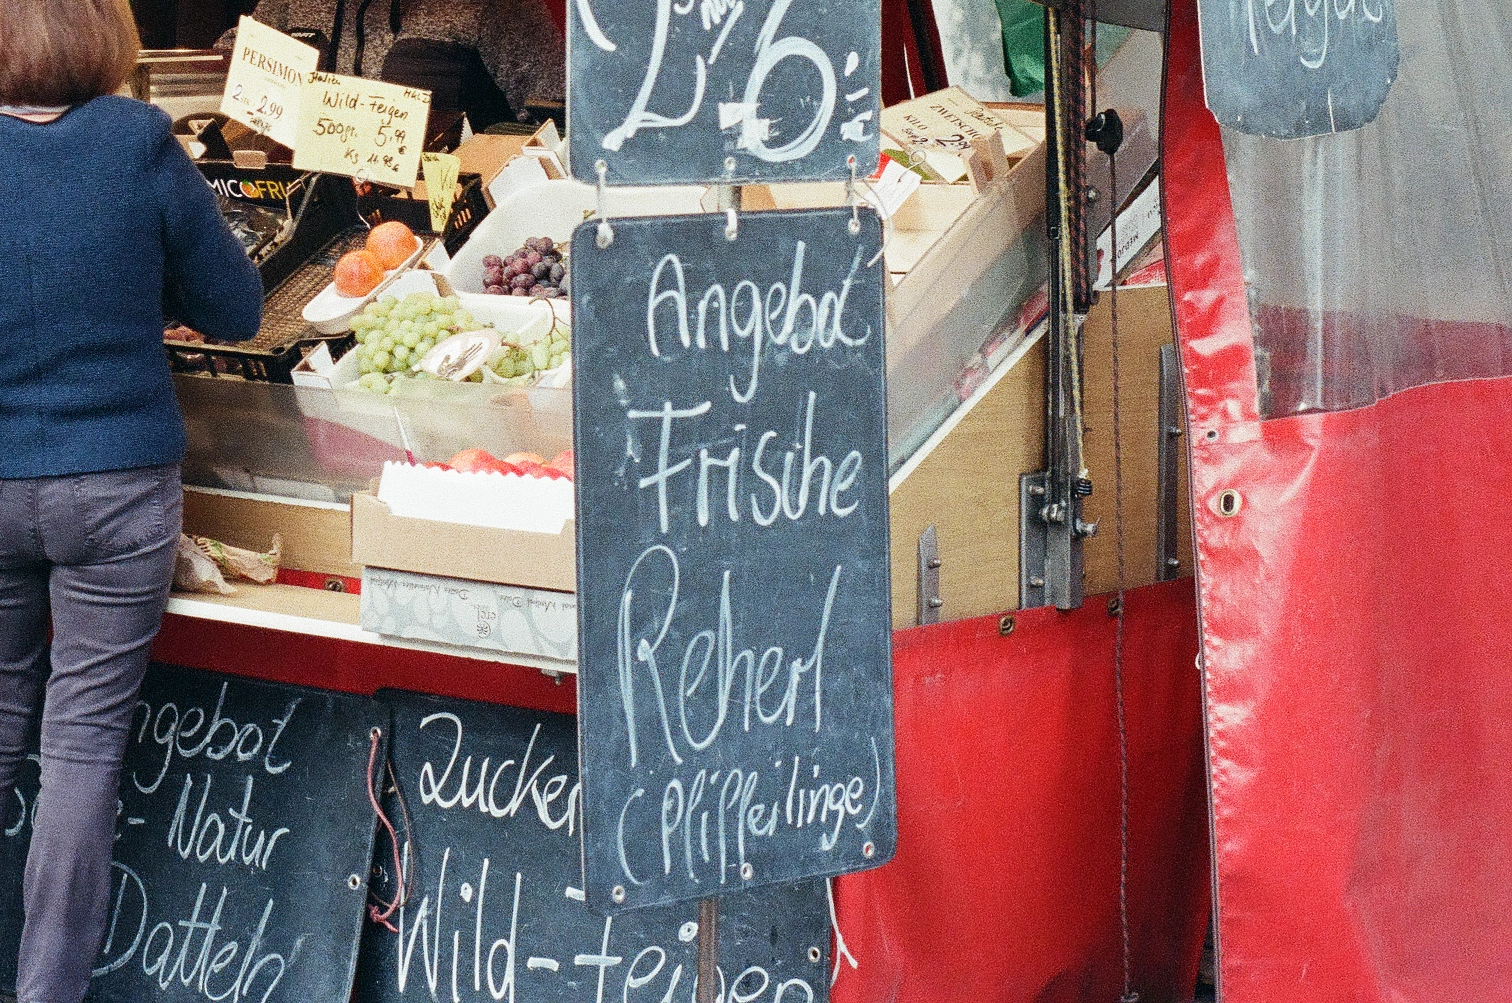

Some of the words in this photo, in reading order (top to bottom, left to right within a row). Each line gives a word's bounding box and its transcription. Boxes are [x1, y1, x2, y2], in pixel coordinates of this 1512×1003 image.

[256, 95, 284, 120] 2.99
[647, 240, 872, 403] Angebot
[627, 391, 863, 533] Frische
